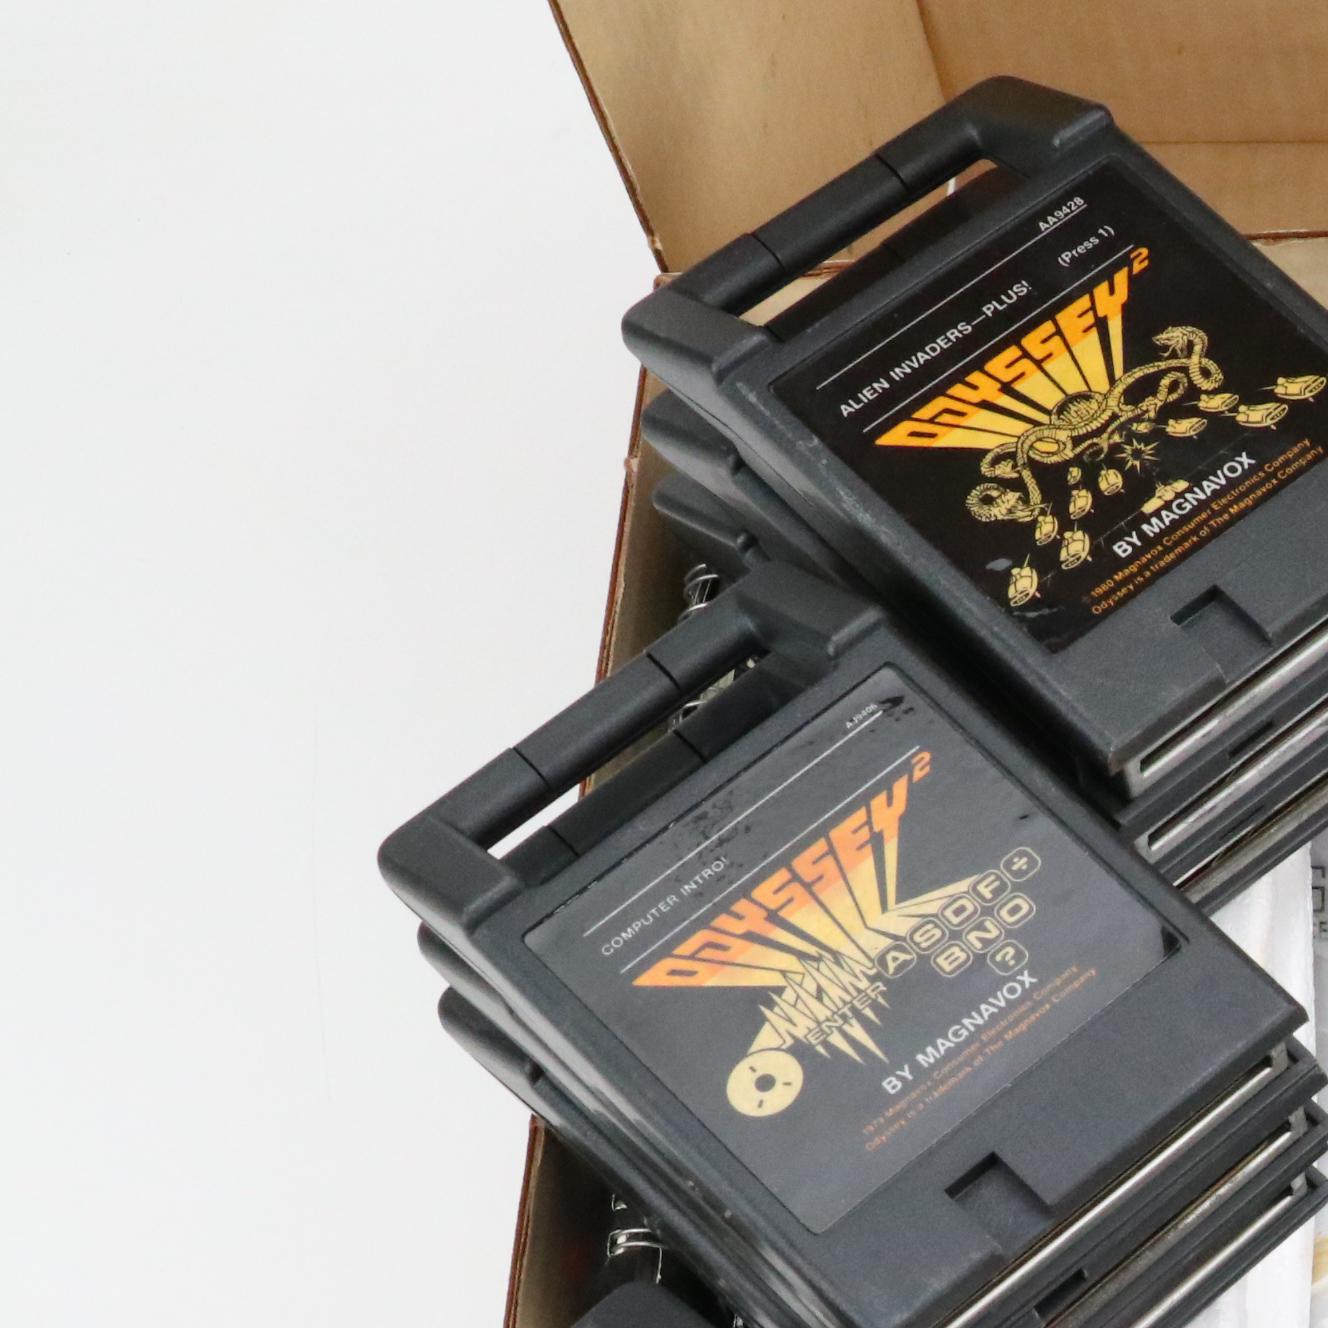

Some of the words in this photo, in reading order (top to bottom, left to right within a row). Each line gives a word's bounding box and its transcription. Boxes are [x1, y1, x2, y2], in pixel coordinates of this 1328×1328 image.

[1039, 197, 1084, 231] AA9428
[840, 378, 889, 416] ALIEN
[1058, 236, 1099, 266] (Press
[1098, 225, 1114, 236] 1)
[1112, 531, 1141, 557] BY
[1141, 451, 1255, 537] MAGNAVOX
[1113, 544, 1162, 581] Magnavox
[1162, 508, 1213, 546] Consumer
[1211, 471, 1266, 511] Electronics
[1264, 438, 1311, 473] Company
[1210, 511, 1231, 529] The
[1229, 478, 1278, 515] Magnavox
[1277, 445, 1324, 480] Company
[601, 895, 678, 955] COMPUTER
[680, 857, 726, 895] INTRO!
[881, 1064, 912, 1094] BY
[915, 969, 1037, 1067] MAGNAVOX
